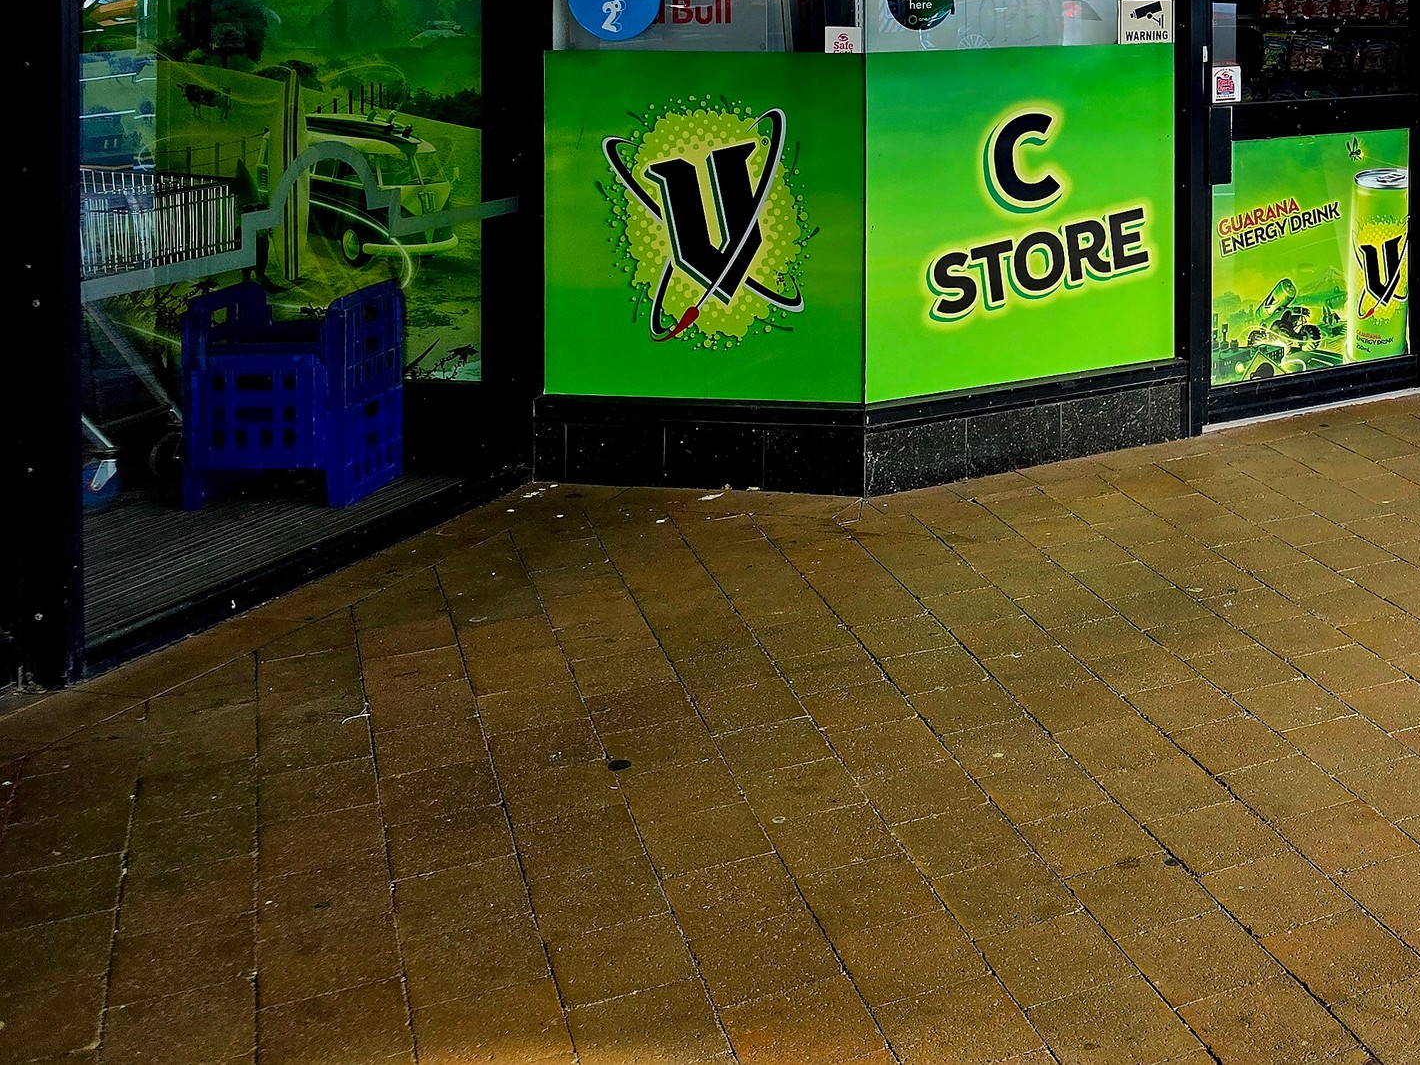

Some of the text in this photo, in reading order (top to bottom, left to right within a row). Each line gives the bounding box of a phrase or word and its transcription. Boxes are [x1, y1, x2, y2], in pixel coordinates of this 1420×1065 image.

[910, 0, 932, 10] here
[834, 40, 854, 50] Safe
[1125, 30, 1168, 41] WARNING
[984, 111, 1063, 213] C
[644, 140, 764, 306] V
[1218, 198, 1300, 236] GUARANA
[1220, 202, 1341, 256] ENERGY DRINK
[926, 206, 1150, 322] STORE
[1358, 235, 1403, 308] V
